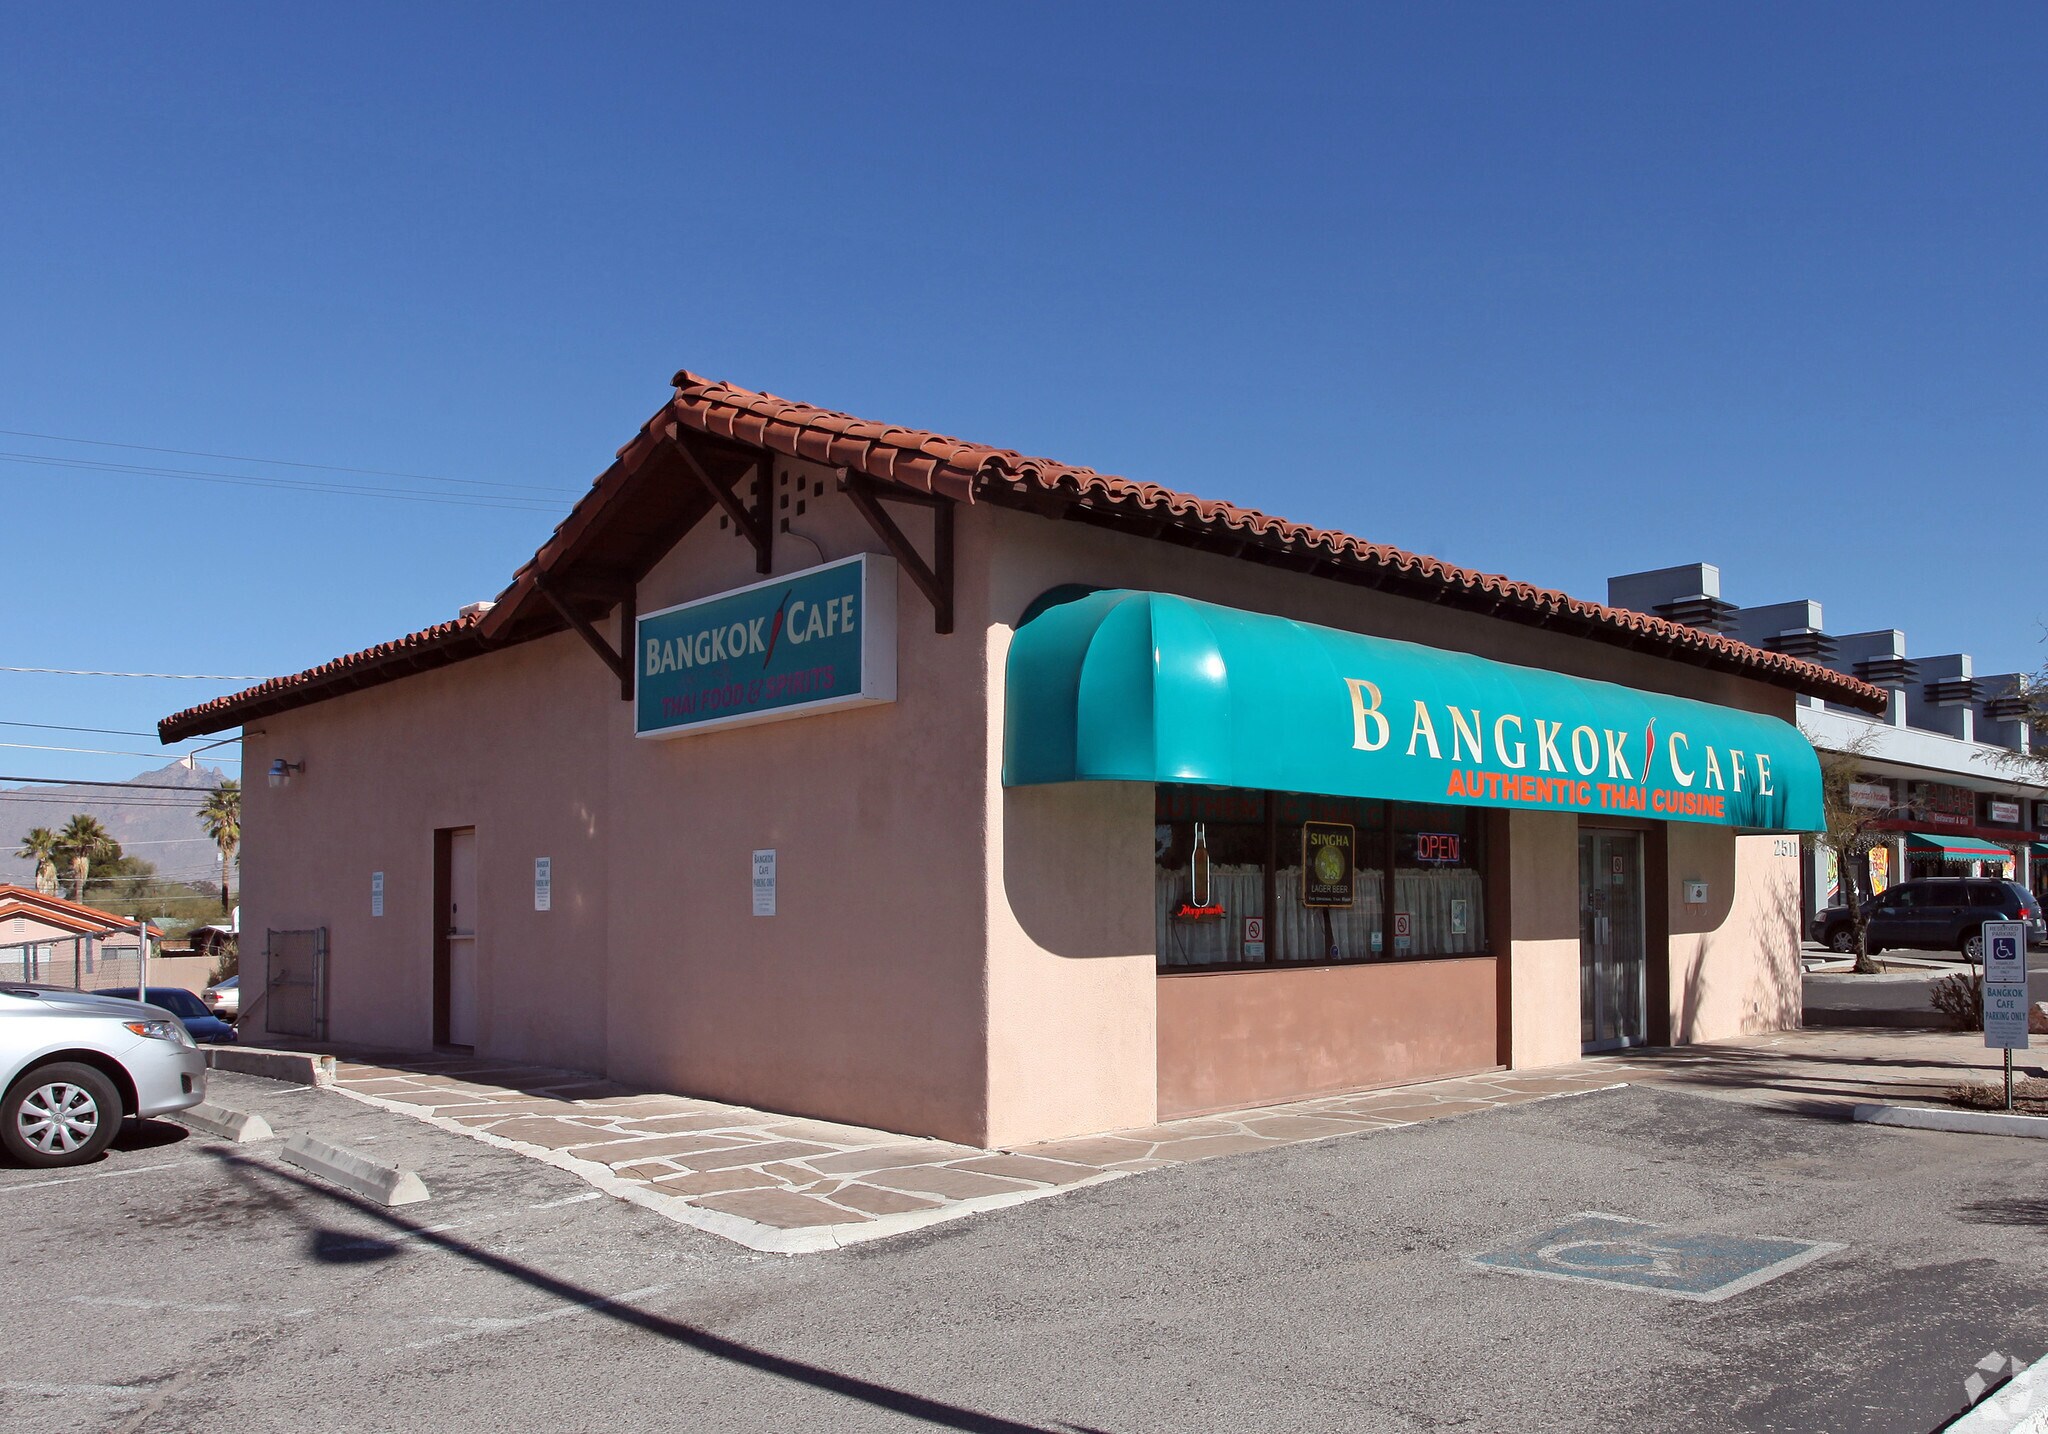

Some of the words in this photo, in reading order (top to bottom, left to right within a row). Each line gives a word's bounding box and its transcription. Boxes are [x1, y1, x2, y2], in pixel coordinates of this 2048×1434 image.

[646, 616, 766, 677] BANGKOK
[786, 595, 855, 645] CAFE
[661, 691, 696, 719] THAI
[701, 683, 744, 711] FOOD
[747, 679, 763, 704] &
[765, 665, 836, 699] SPIRITS
[1343, 677, 1634, 780] BANGKOK
[1668, 731, 1774, 797] CAFE
[1446, 769, 1591, 806] AUTHENTIC
[1596, 782, 1646, 811] THAI
[1651, 788, 1725, 818] CUISINE
[1310, 832, 1349, 847] SINGHA
[1419, 835, 1458, 859] OPEN
[1774, 839, 1798, 858] 2511
[1311, 884, 1332, 894] LAGER
[1332, 884, 1349, 895] BEER
[1987, 987, 2024, 998] BANGKOK
[1996, 999, 2014, 1009] CAFE
[1986, 1011, 2010, 1021] PARKING
[2010, 1011, 2026, 1021] ONLY
